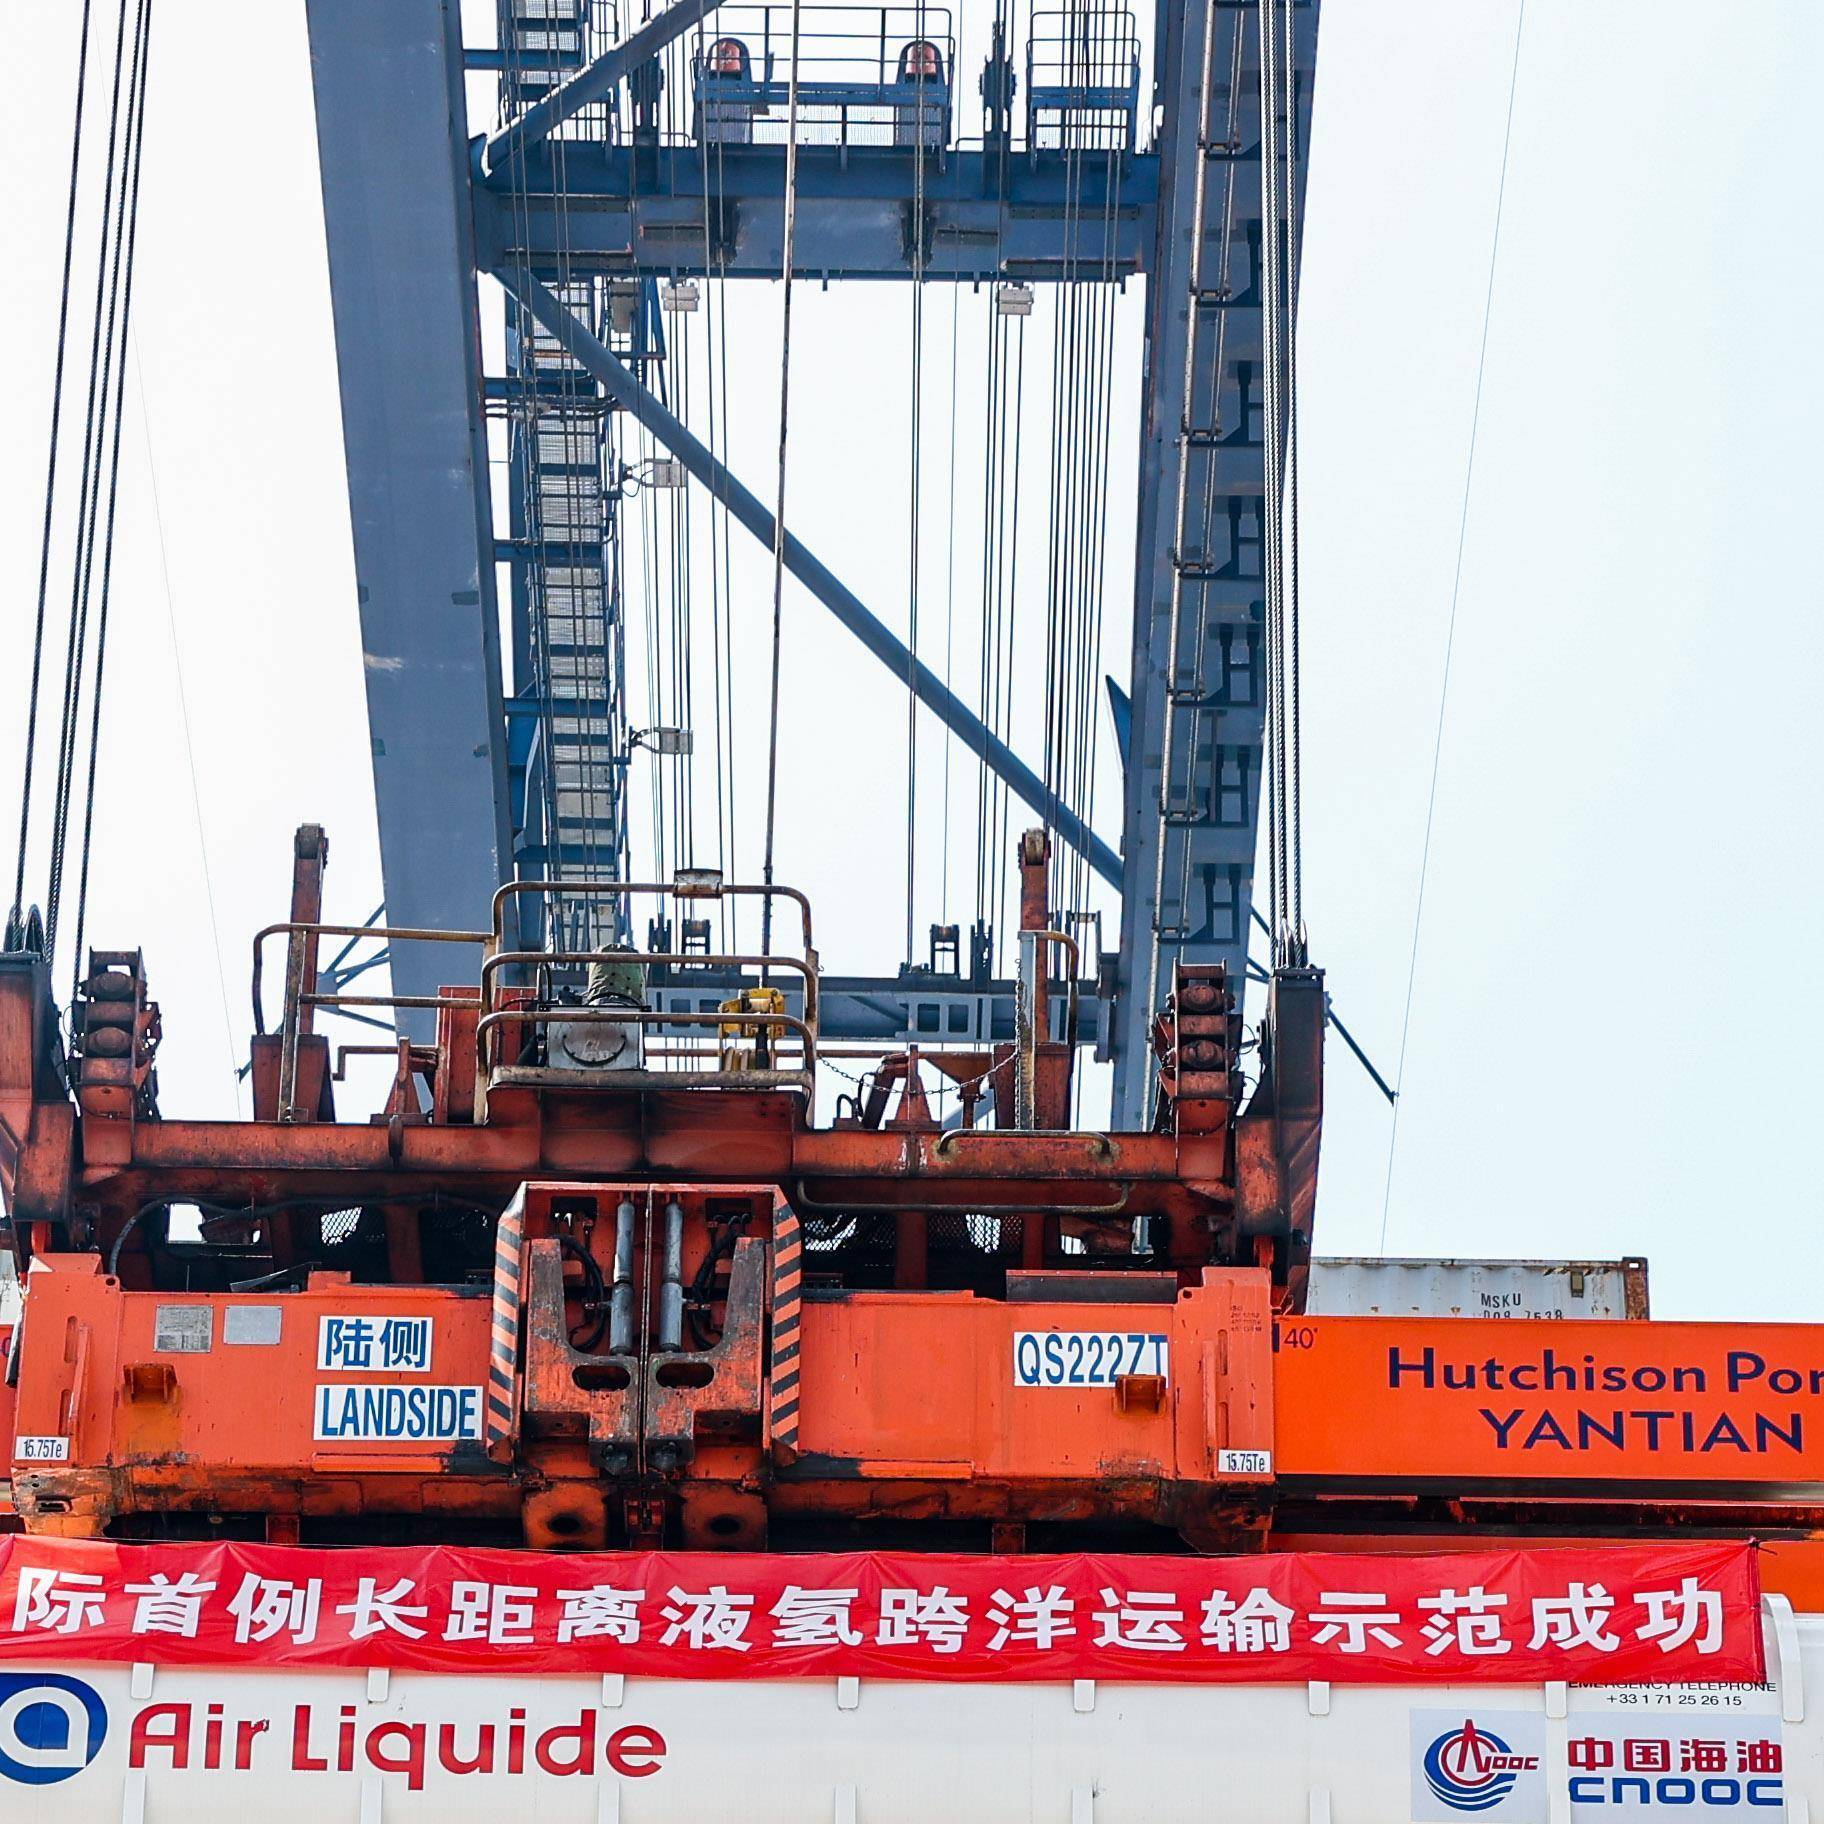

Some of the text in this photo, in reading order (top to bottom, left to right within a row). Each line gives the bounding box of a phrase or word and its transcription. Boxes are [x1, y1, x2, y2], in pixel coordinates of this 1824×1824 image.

[1481, 1293, 1521, 1308] MSKU
[325, 1318, 429, 1370] 陆侧
[1387, 1346, 1707, 1394] Hutchison
[322, 1386, 478, 1439] LANDSIDE
[1479, 1408, 1805, 1455] YANTIAN
[130, 1703, 667, 1791] Air Liquide
[1568, 1737, 1783, 1773] 中国海油
